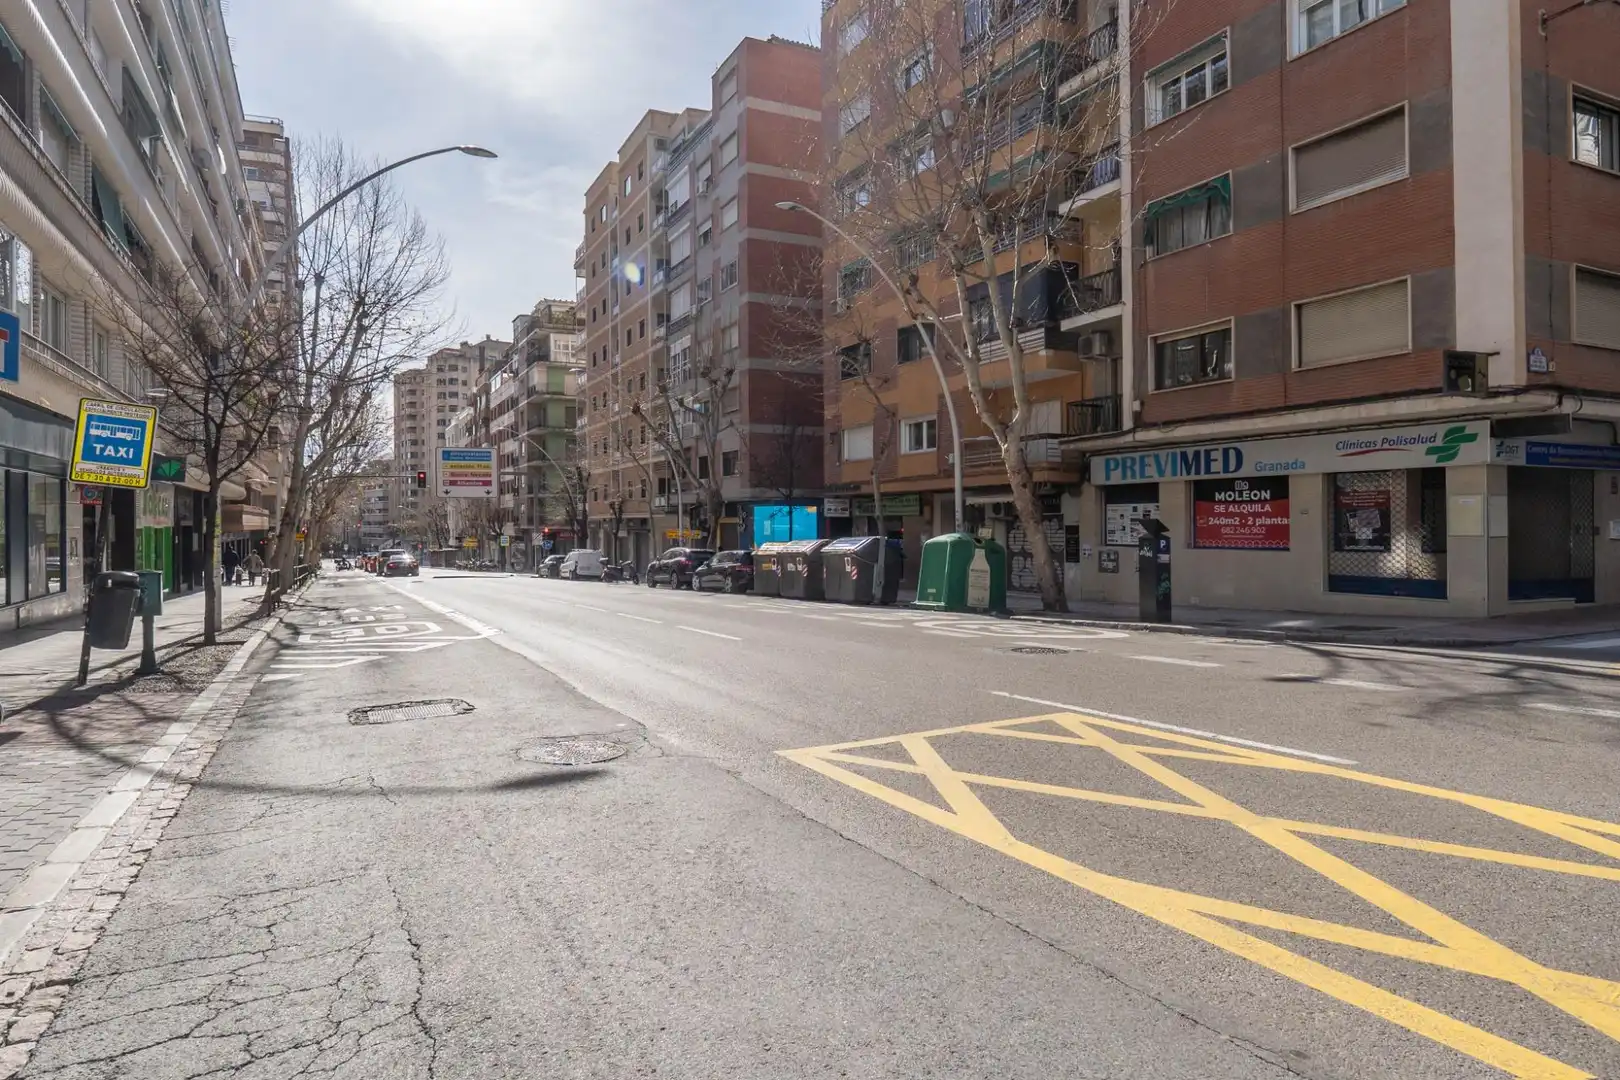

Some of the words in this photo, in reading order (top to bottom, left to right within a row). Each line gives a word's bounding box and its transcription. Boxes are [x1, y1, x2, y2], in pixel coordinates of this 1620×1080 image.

[1380, 432, 1438, 448] Polisalud
[93, 444, 134, 459] TAXI
[1104, 446, 1244, 481] PREVIMED
[1255, 458, 1306, 473] Granada
[1214, 504, 1226, 513] SE
[1228, 503, 1272, 514] ALQUILA
[1208, 516, 1240, 525] 240m2
[1247, 516, 1254, 525] 2
[1255, 516, 1290, 526] planta
[1221, 526, 1235, 534] 682
[1251, 526, 1266, 534] 902
[1160, 540, 1167, 549] P
